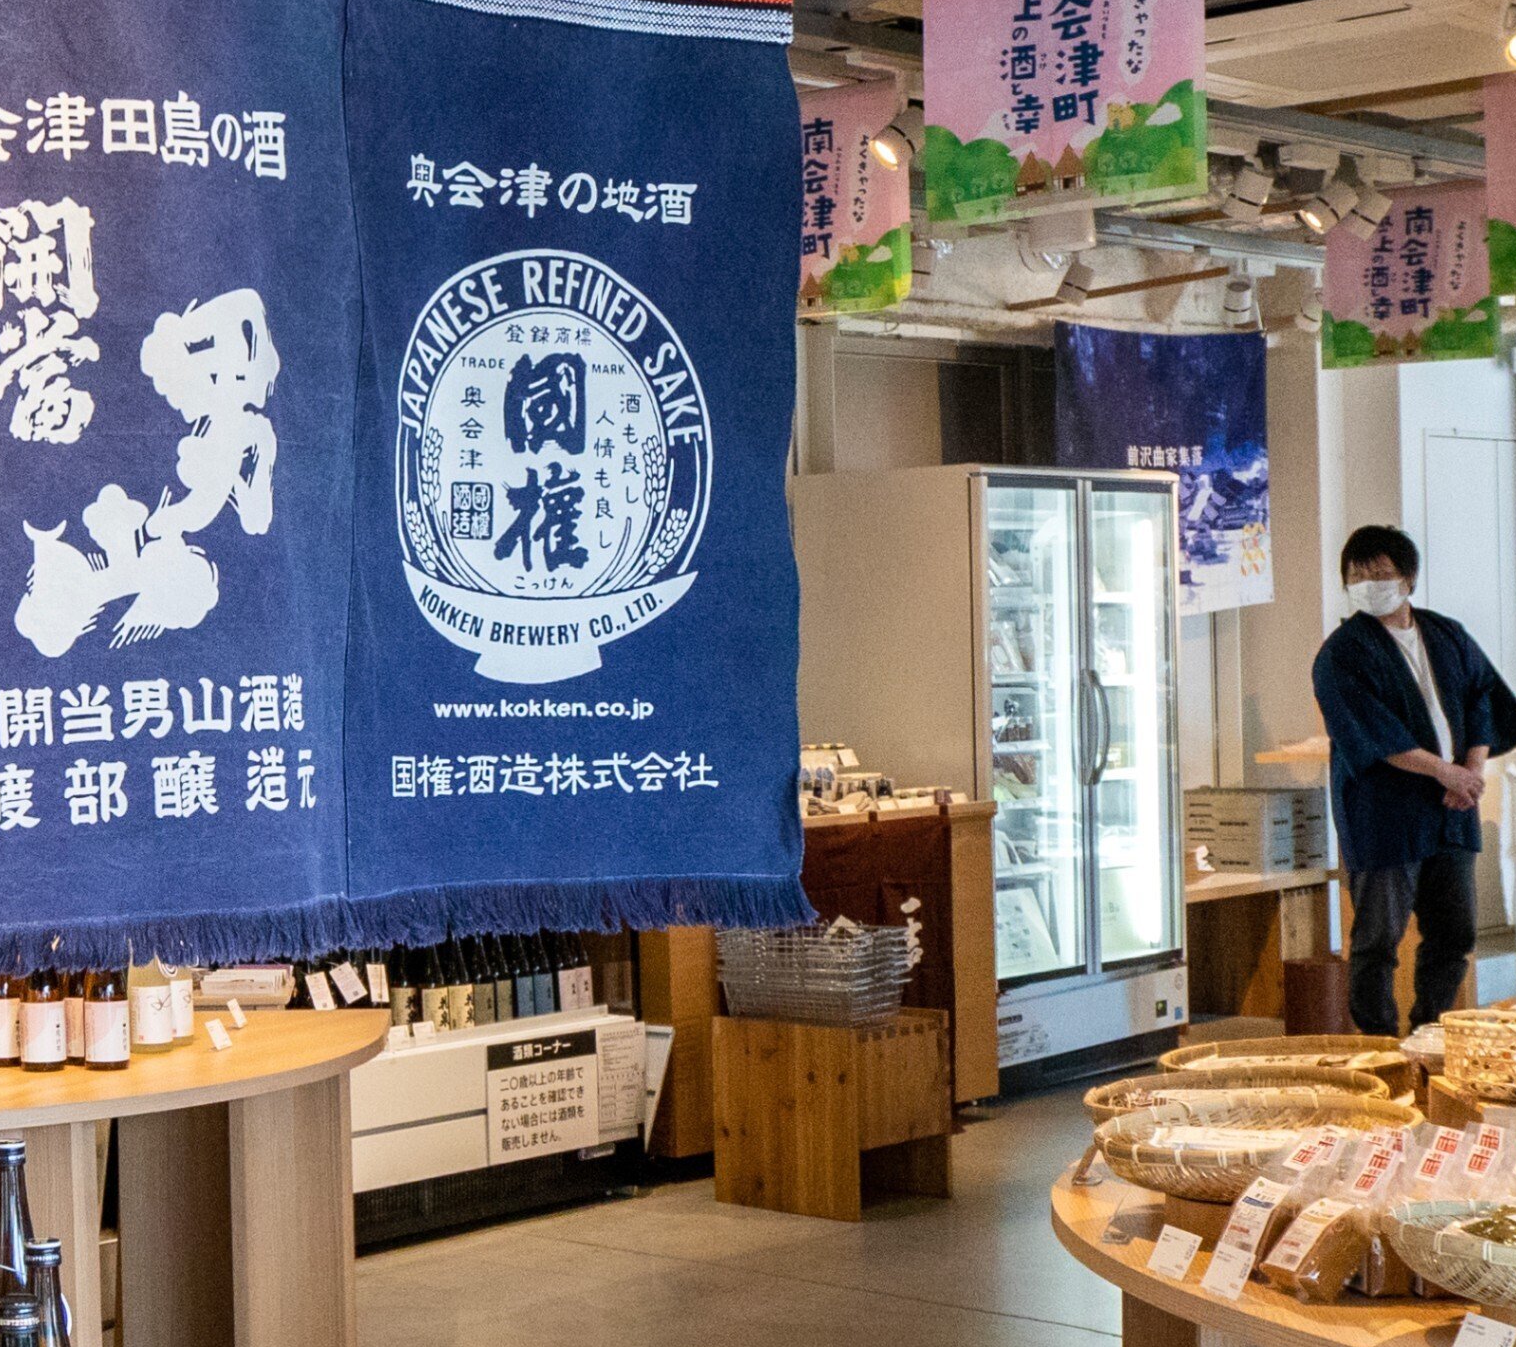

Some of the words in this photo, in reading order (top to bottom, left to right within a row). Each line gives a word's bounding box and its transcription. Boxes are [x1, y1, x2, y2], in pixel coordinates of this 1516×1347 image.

[407, 152, 699, 227] 奥会津の地酒
[803, 118, 837, 259] 南会津町
[1399, 205, 1435, 319] 南会津町
[401, 267, 509, 440] JAPANESE
[522, 259, 649, 343] REFINED
[644, 341, 704, 447] SAKE
[504, 324, 593, 347] 登録商標
[460, 355, 506, 370] TRADE
[591, 362, 625, 376] MARK
[459, 386, 486, 470] 奥会津
[619, 393, 642, 505] 酒も良し
[593, 409, 616, 550] 人情も良し
[514, 575, 575, 590] こっけん
[418, 585, 484, 639] KOKKEN
[489, 620, 580, 647] BREWERY
[433, 696, 655, 723] www.kokken.co.jp
[391, 750, 721, 801] 国権酒造株式会社
[512, 1042, 571, 1061] 酒類コーナー
[500, 1086, 584, 1112] あることを確認でき
[500, 1105, 585, 1132] ない場合には酒類を
[501, 1130, 562, 1152] 販売しません。
